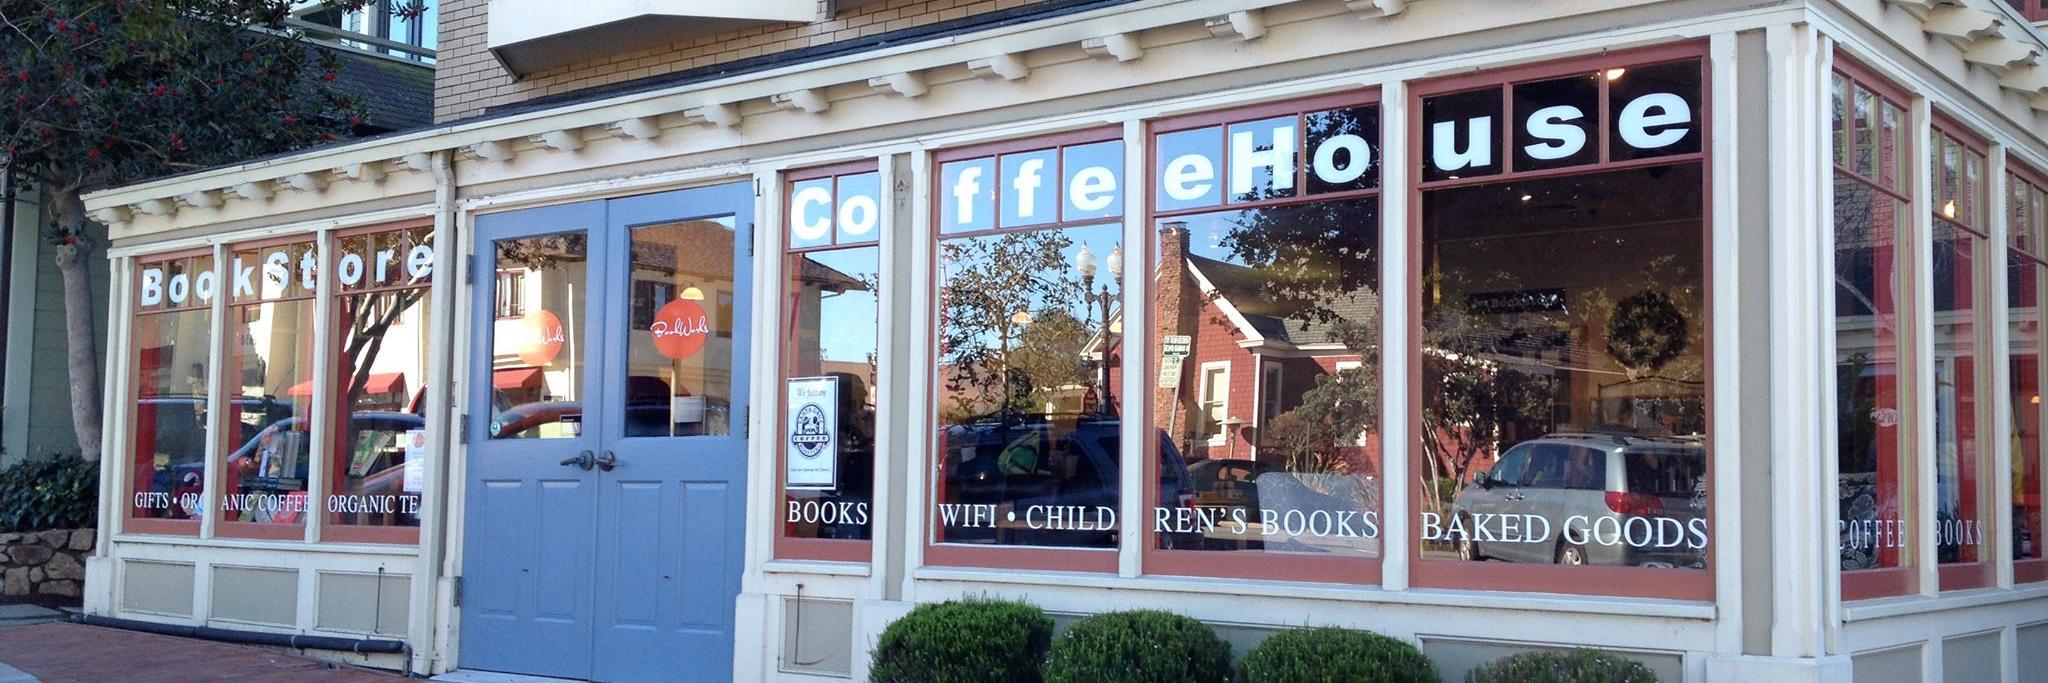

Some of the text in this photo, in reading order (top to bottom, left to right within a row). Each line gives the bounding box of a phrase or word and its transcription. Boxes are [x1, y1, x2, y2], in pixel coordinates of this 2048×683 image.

[134, 491, 169, 509] GIFTS
[327, 494, 396, 515] ORGANIC
[399, 495, 422, 515] TE
[786, 500, 869, 526] BOOKS
[938, 503, 997, 529] WIFI
[1260, 508, 1379, 539] BOOKS
[1420, 511, 1708, 549] BAKED GOODS
[1935, 519, 1983, 546] BOOKS
